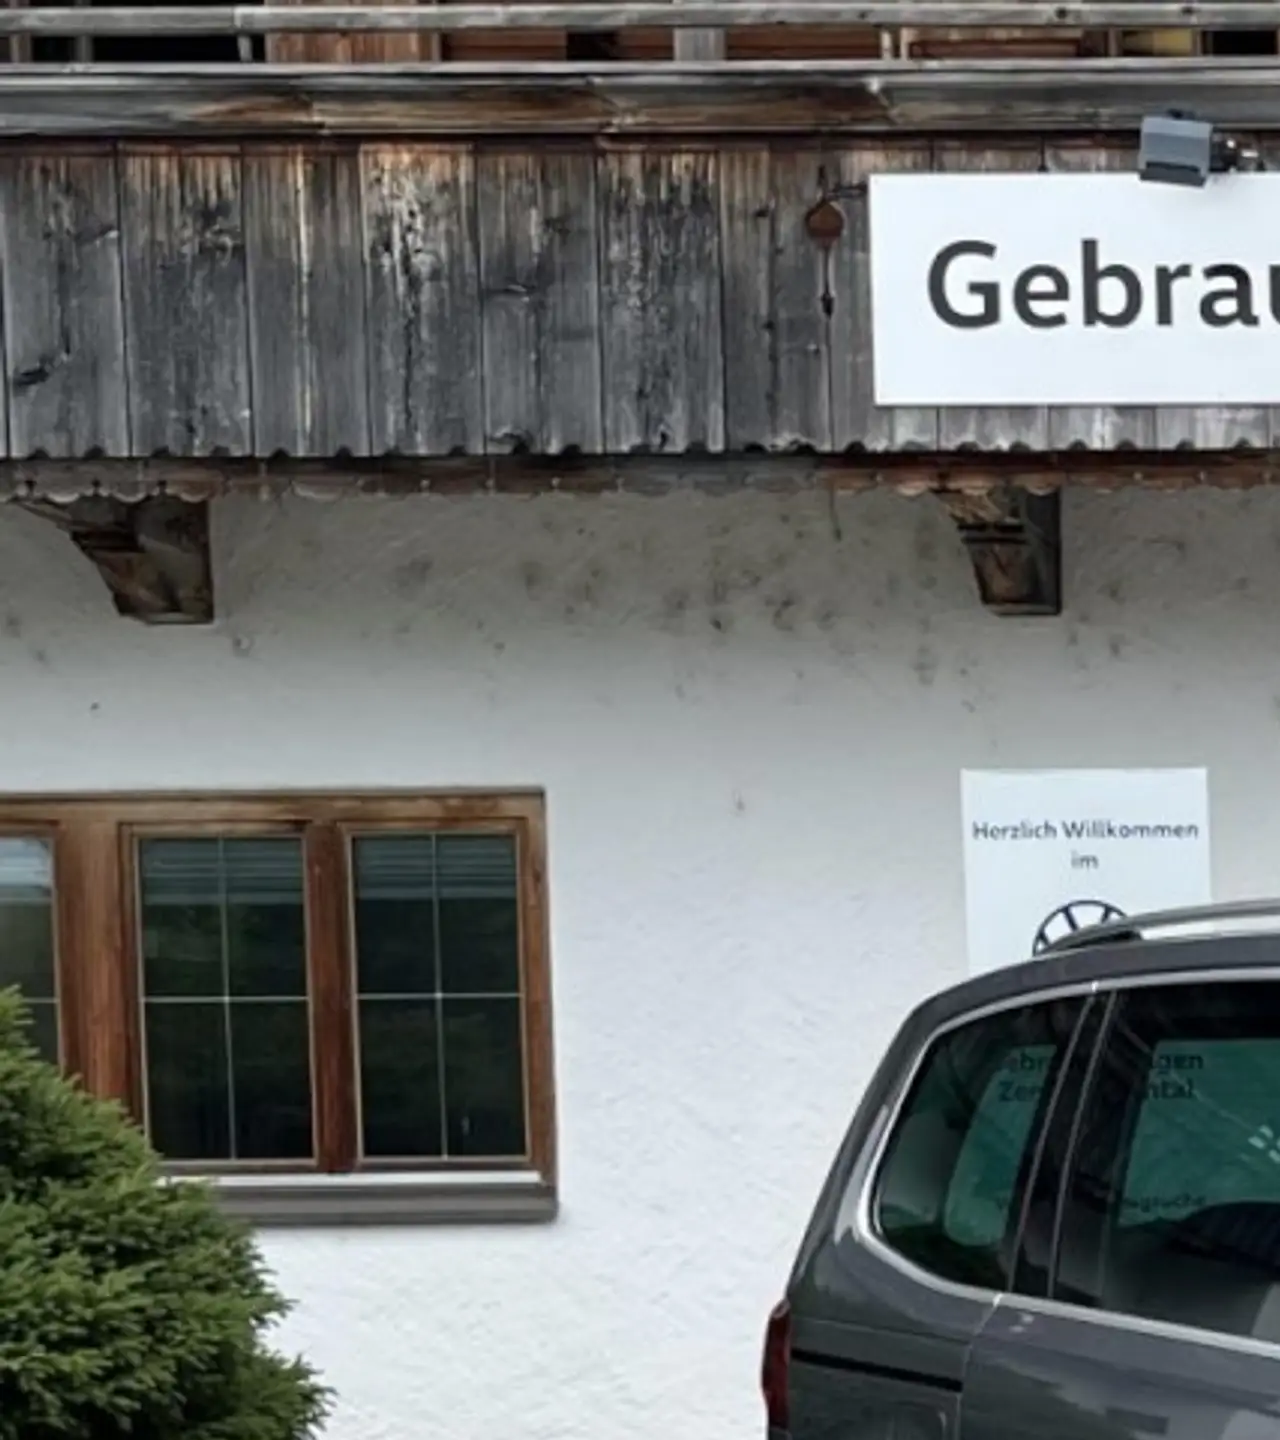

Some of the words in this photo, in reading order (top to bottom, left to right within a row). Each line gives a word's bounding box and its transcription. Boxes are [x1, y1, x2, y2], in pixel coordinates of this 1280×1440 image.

[972, 820, 1057, 841] Herzlich
[1060, 819, 1199, 841] Willkommen
[1070, 851, 1099, 870] im
